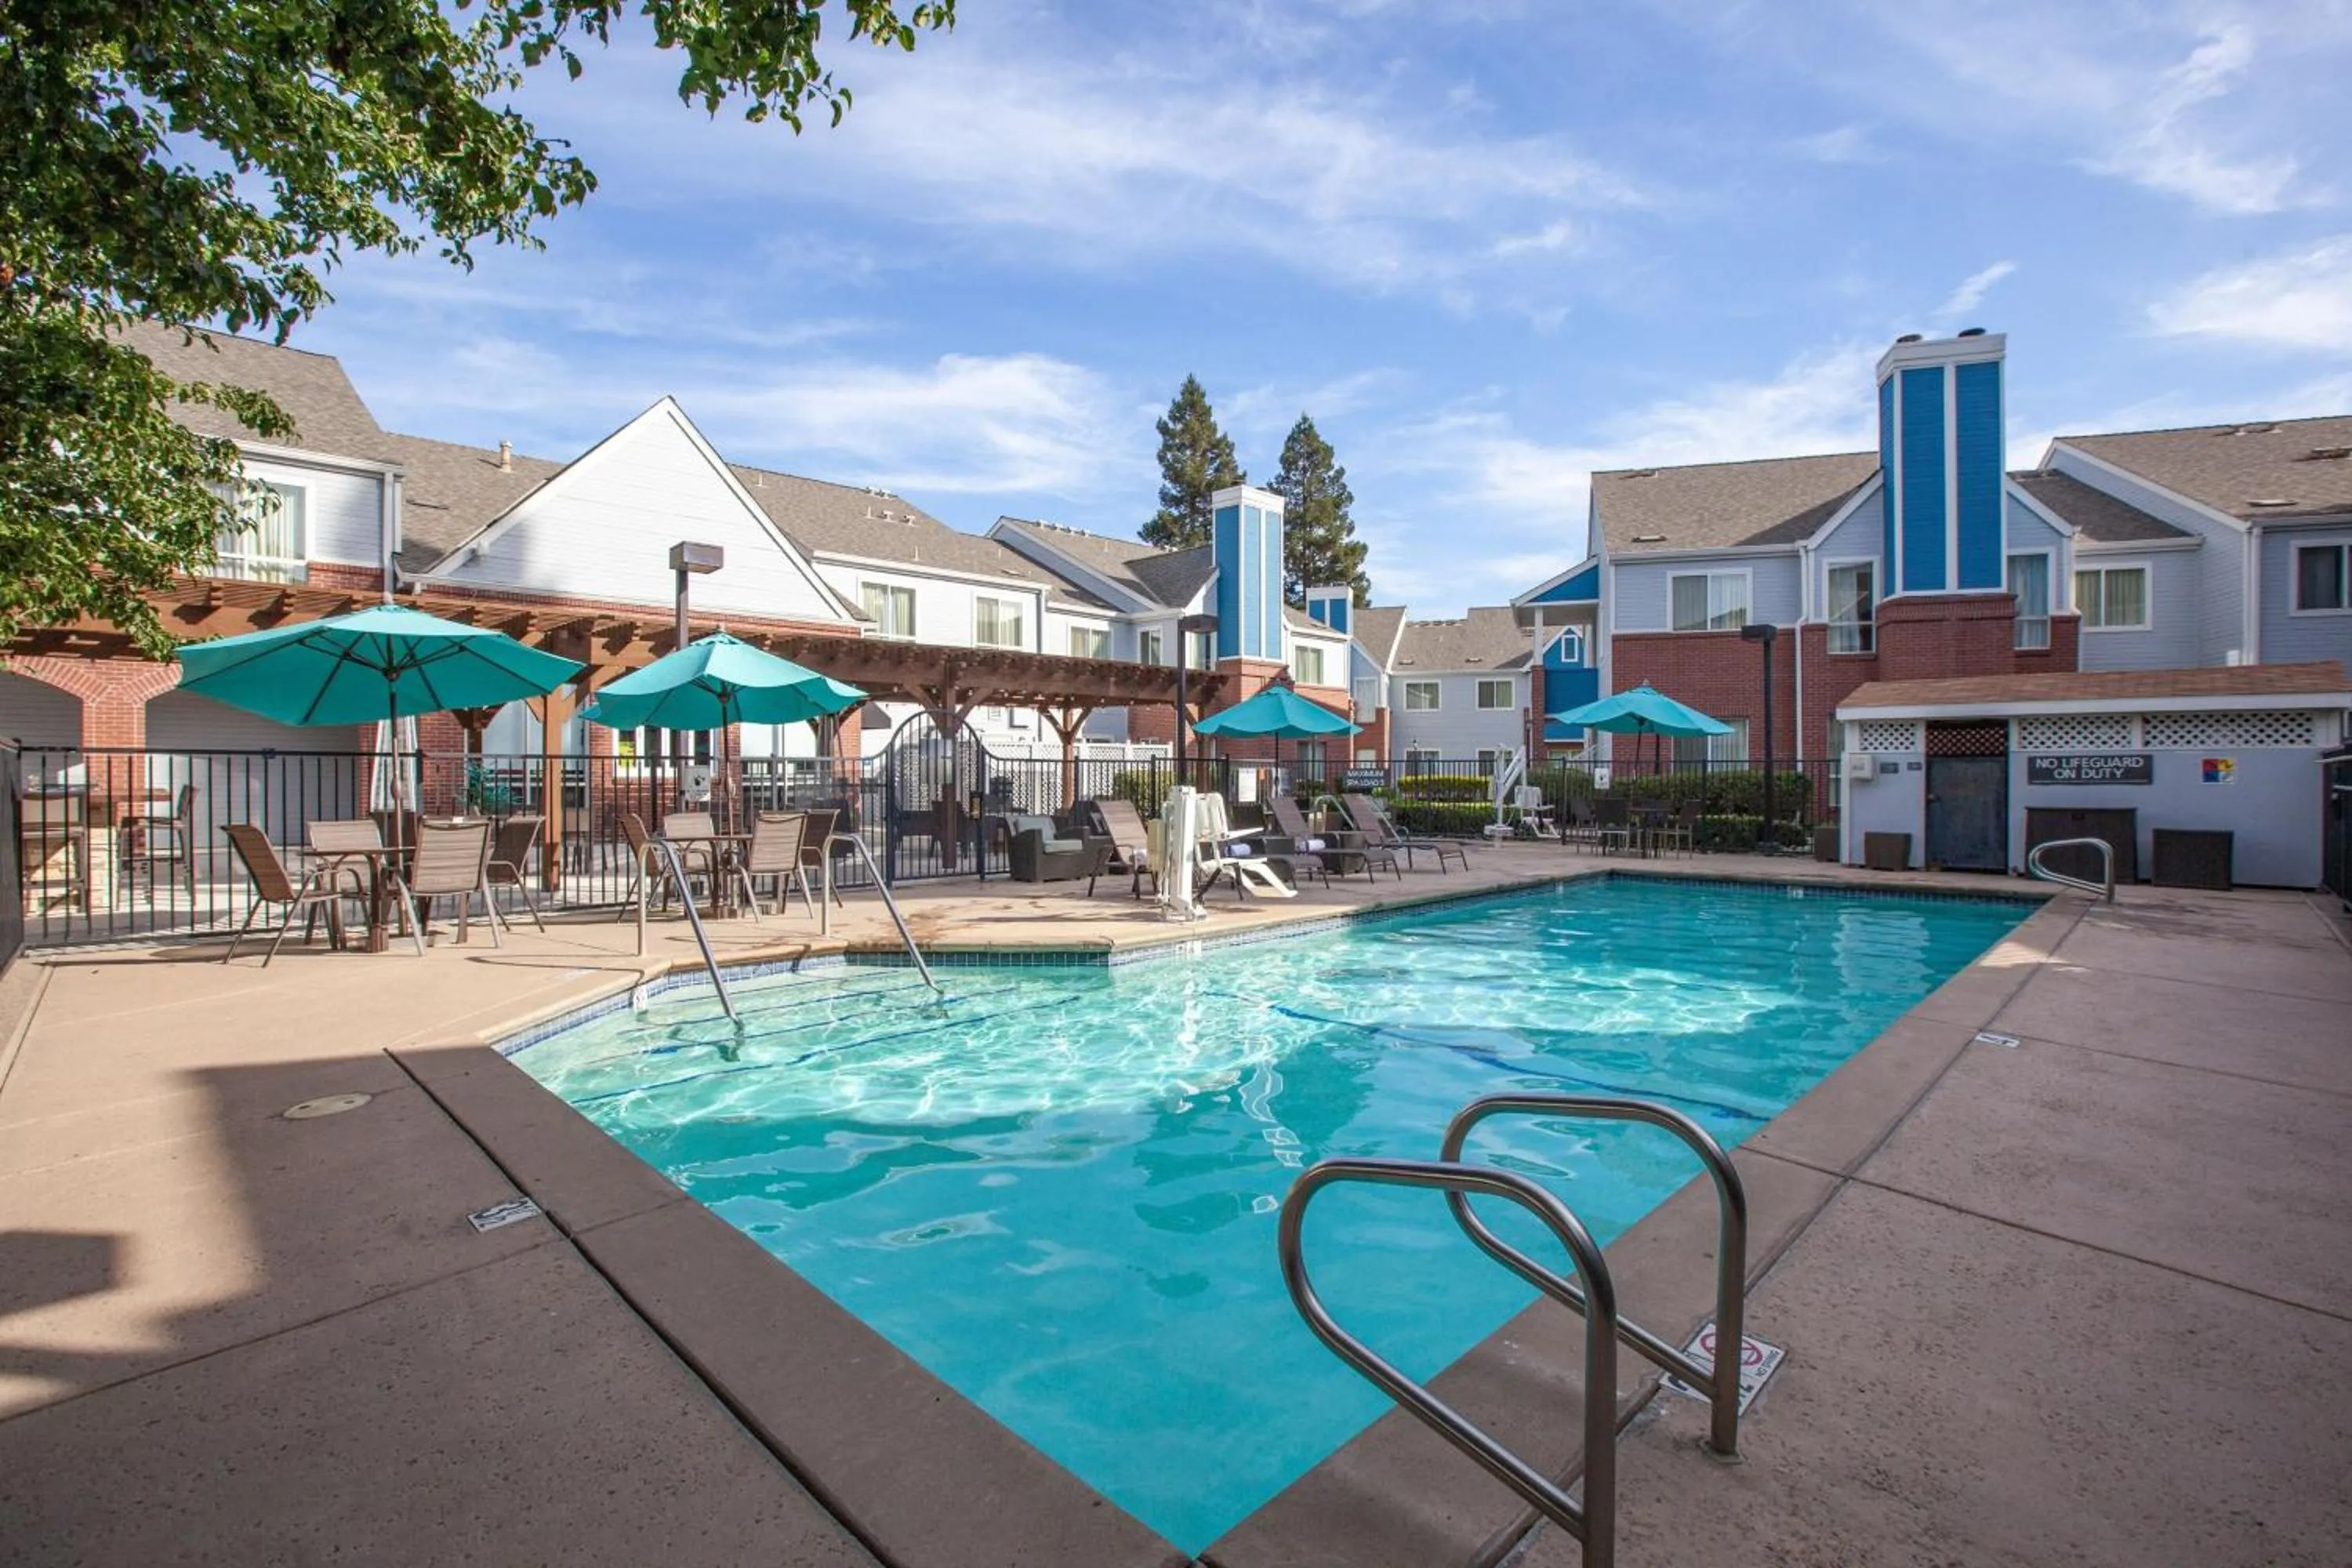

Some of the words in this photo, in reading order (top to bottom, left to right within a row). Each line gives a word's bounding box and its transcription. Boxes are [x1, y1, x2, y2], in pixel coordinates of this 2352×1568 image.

[2036, 757, 2058, 769] NO
[2062, 757, 2144, 768] LIFEGUARD
[2053, 768, 2075, 779] ON
[2082, 768, 2125, 779] DUTY
